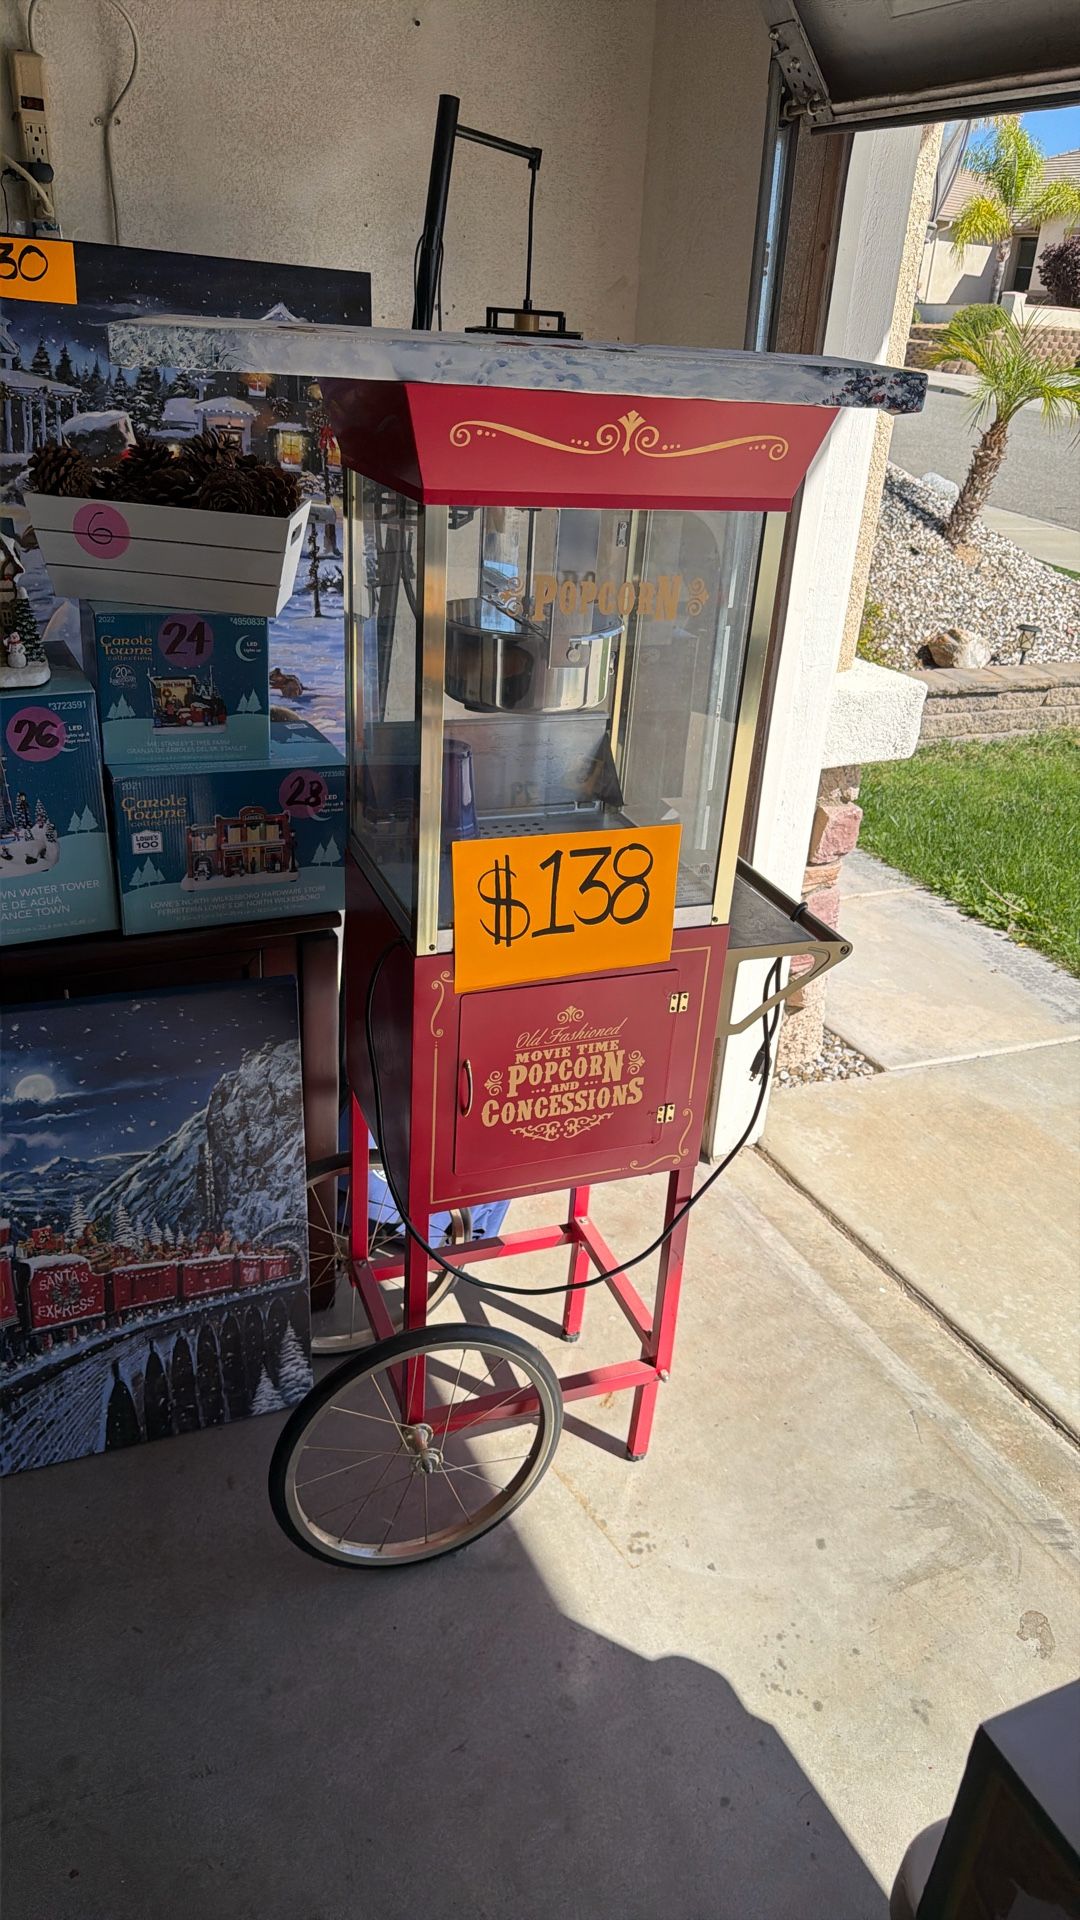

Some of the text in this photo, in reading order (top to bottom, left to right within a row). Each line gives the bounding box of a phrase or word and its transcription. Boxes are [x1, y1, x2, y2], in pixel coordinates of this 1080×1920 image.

[87, 511, 113, 545] 6
[531, 574, 684, 622] POPCORN
[98, 615, 116, 623] 2022
[103, 644, 153, 656] Towne
[162, 621, 211, 656] 24
[13, 719, 60, 752] 26
[286, 775, 324, 807] 28
[123, 808, 187, 822] Towne
[136, 841, 159, 849] 100
[20, 884, 59, 897] WATER
[61, 880, 100, 892] TOWER
[477, 843, 654, 948] $138
[11, 900, 30, 910] DE
[30, 895, 63, 908] AGUA
[36, 904, 71, 916] TOWN
[515, 1017, 628, 1049] Old Fashioned
[515, 1039, 620, 1065] MOVIE TIME
[506, 1049, 626, 1098] POPCORN
[549, 1081, 580, 1093] AND
[481, 1076, 645, 1127] CONCESSIONS
[37, 1296, 96, 1319] EXPRESS
